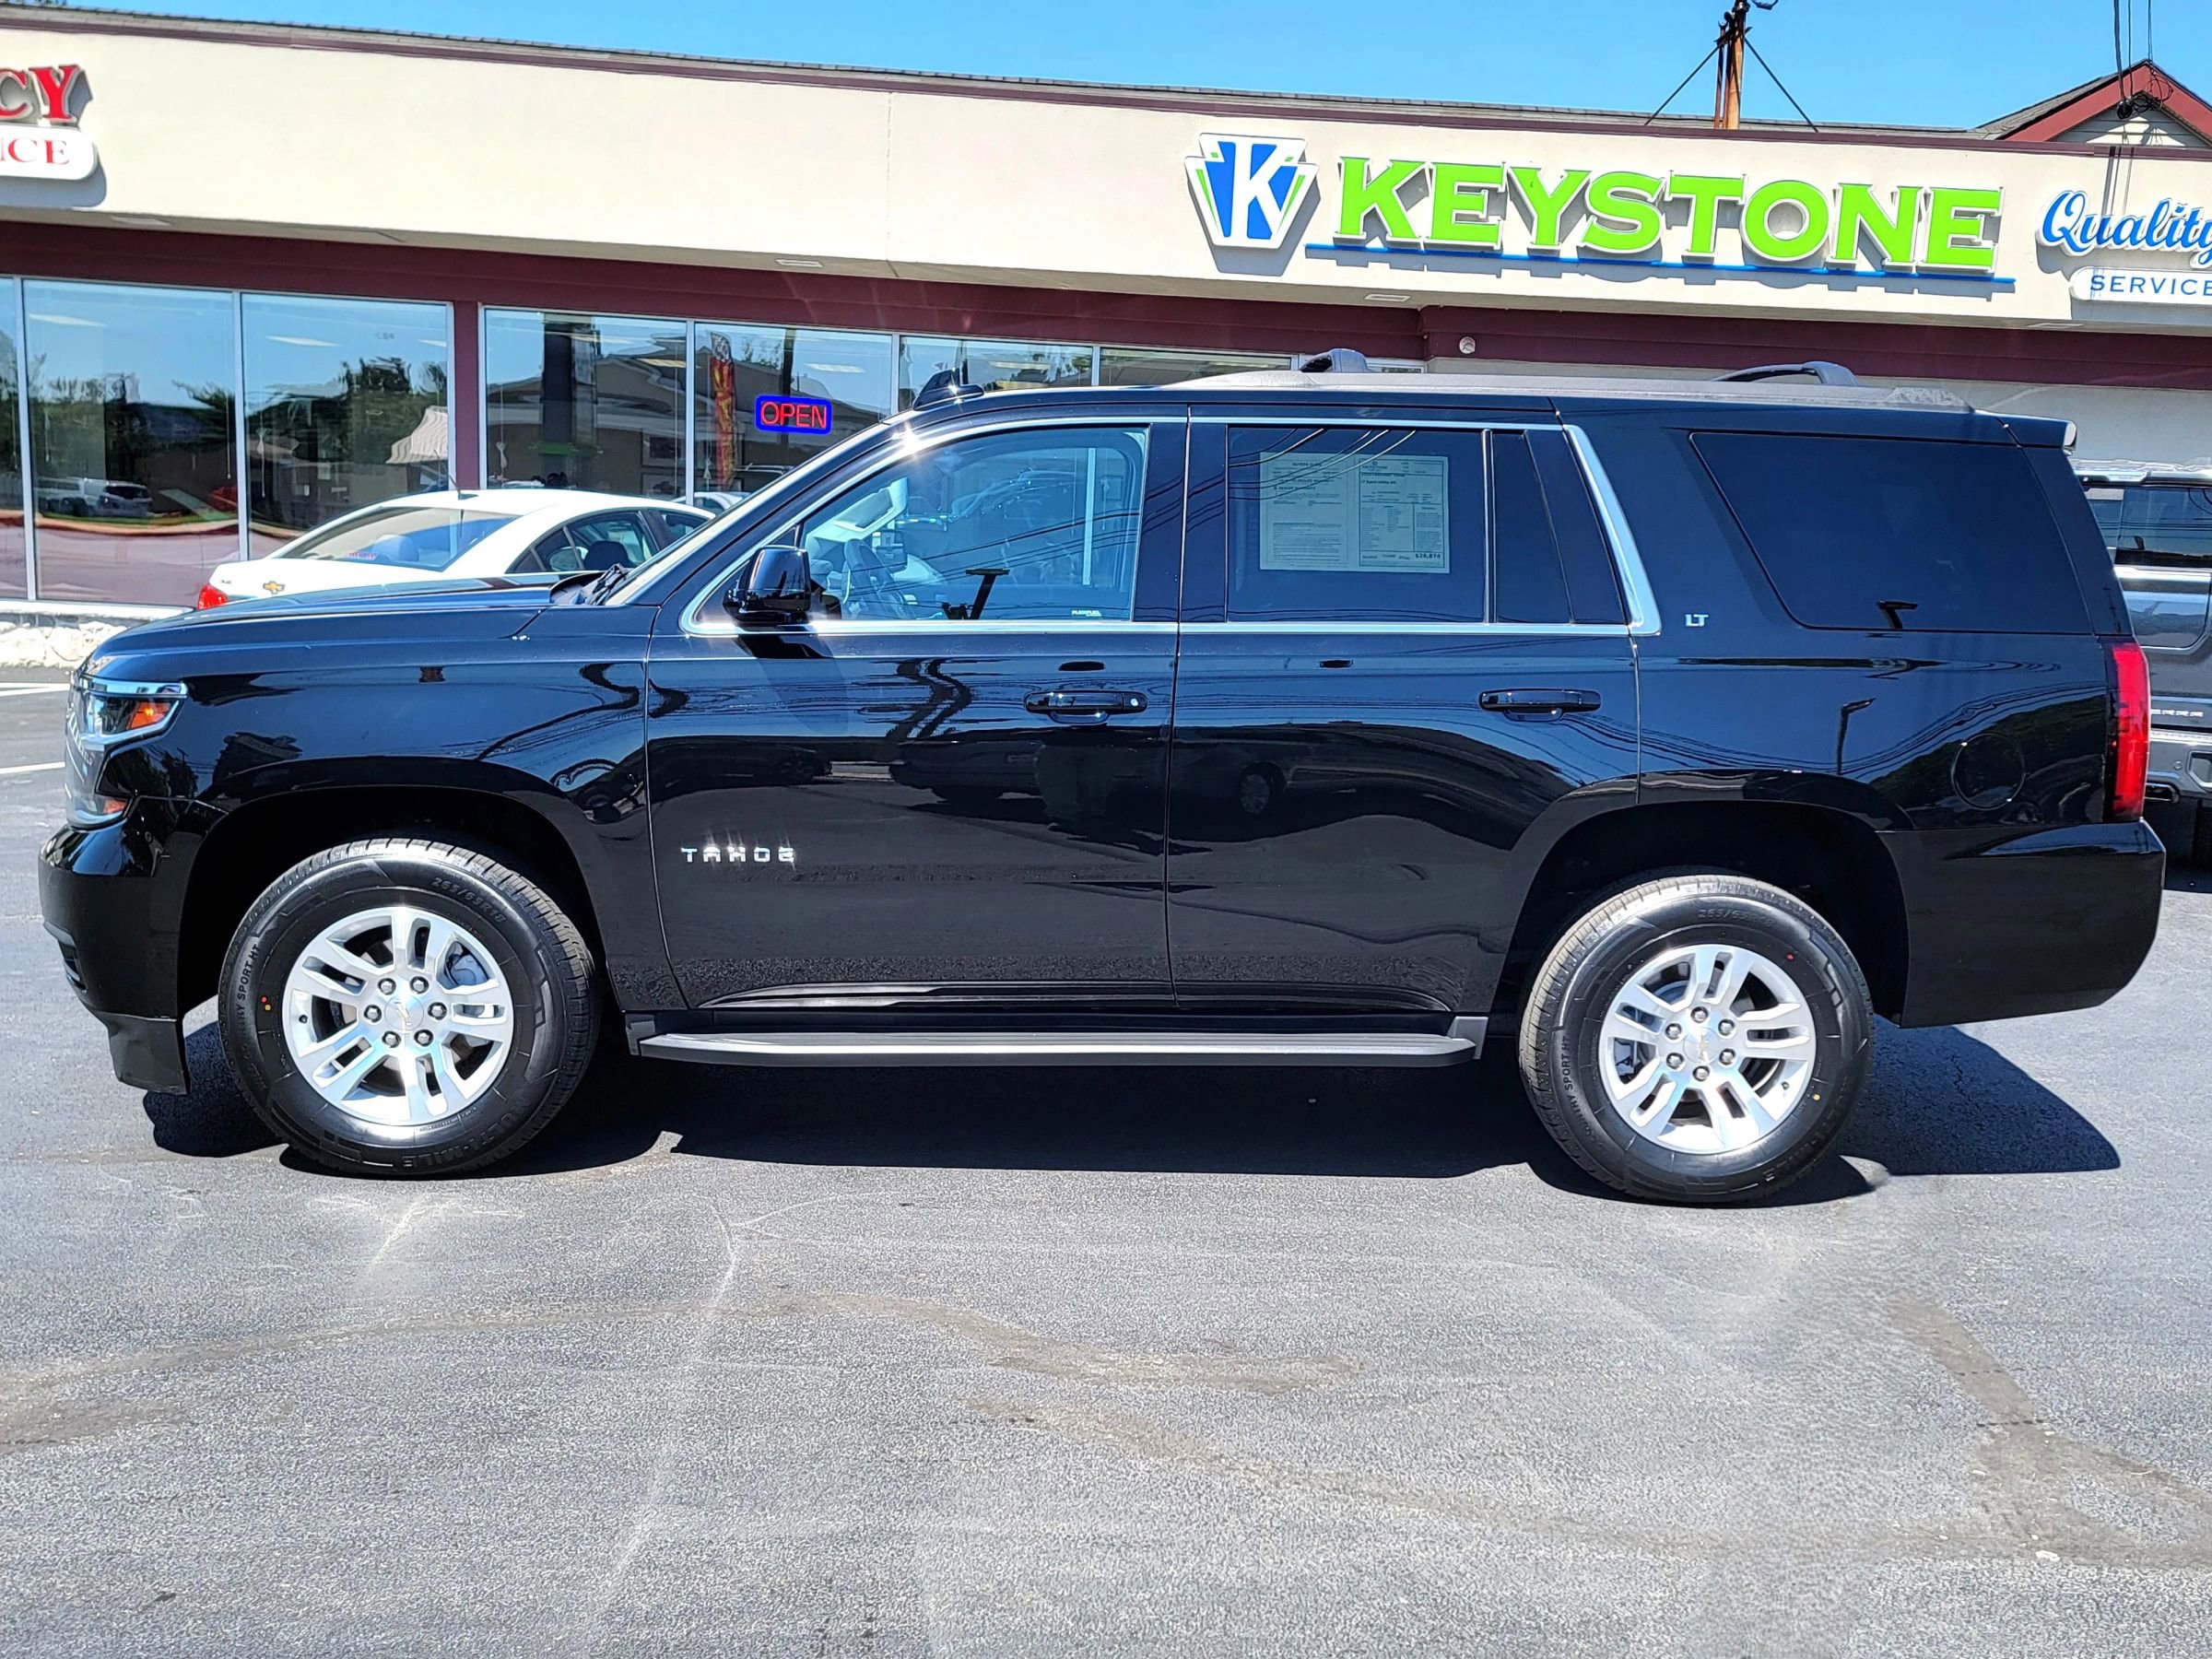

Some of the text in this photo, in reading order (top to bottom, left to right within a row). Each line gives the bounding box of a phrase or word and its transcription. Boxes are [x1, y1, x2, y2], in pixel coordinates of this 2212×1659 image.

[0, 138, 69, 165] CE
[1333, 155, 2005, 273] KEYSTONE
[760, 401, 827, 429] OPEN
[1685, 614, 1709, 627] LT
[681, 845, 794, 863] TAHOE
[431, 877, 507, 923] 265/65R18
[237, 960, 253, 1002] SPORT
[248, 943, 261, 960] HT
[1560, 1035, 1571, 1051] HT
[1560, 1053, 1574, 1091] SPORT
